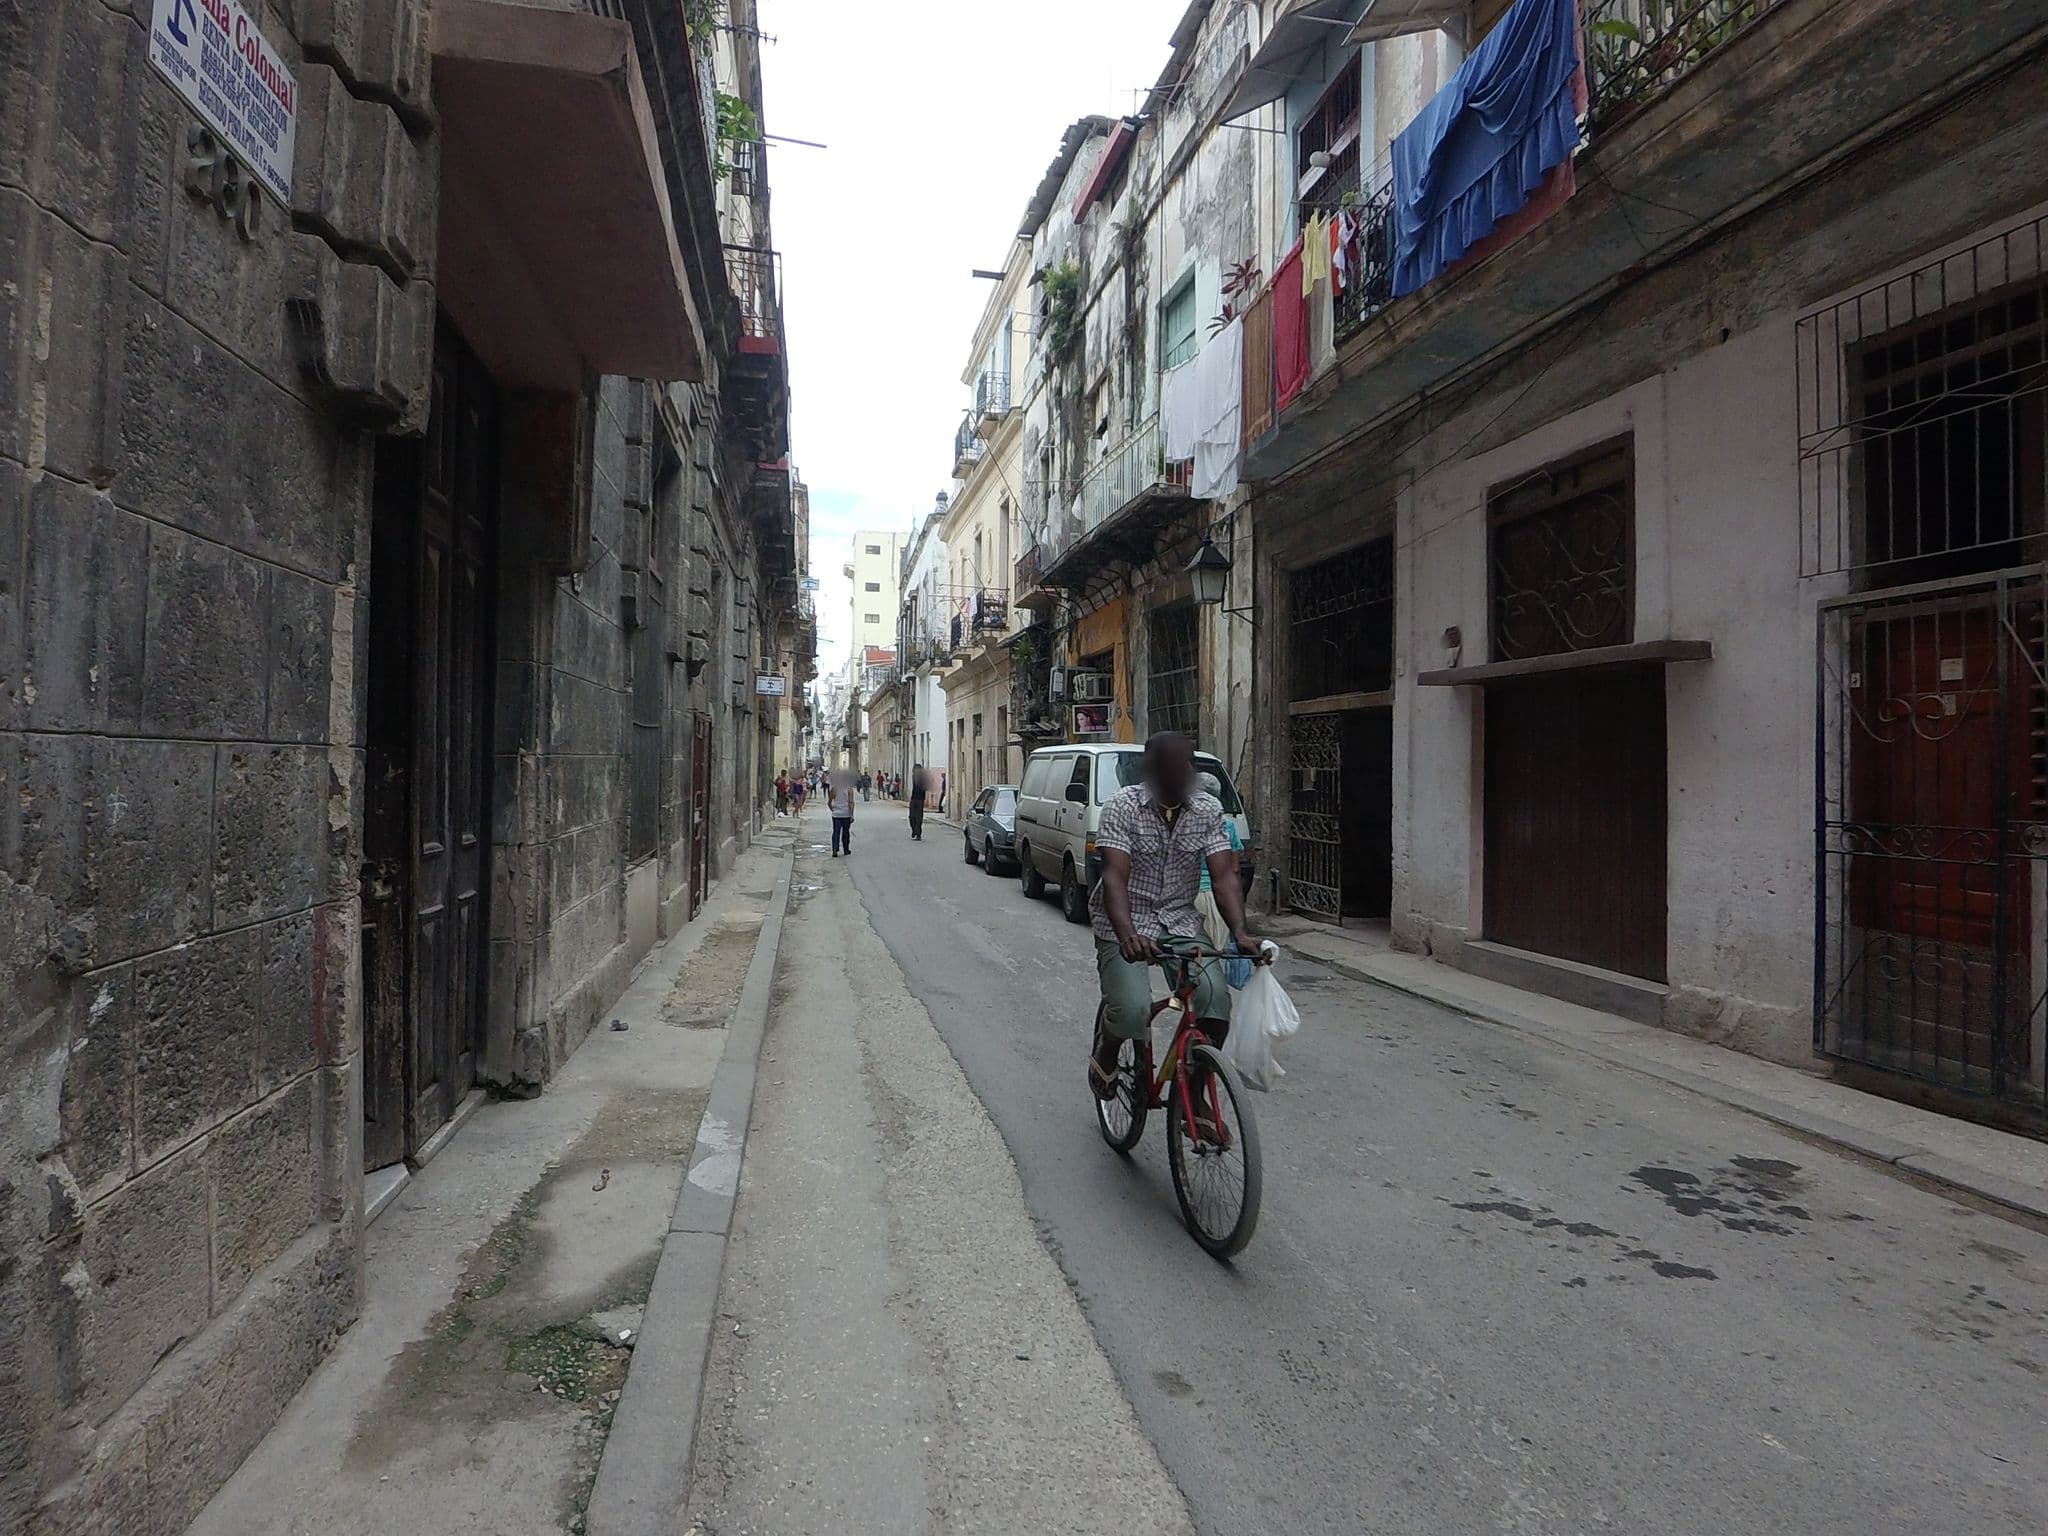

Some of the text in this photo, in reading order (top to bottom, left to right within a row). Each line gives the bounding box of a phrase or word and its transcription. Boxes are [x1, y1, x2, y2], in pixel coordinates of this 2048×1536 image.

[203, 13, 230, 65] RENTA
[232, 50, 243, 79] DE
[235, 14, 293, 116] Colonial
